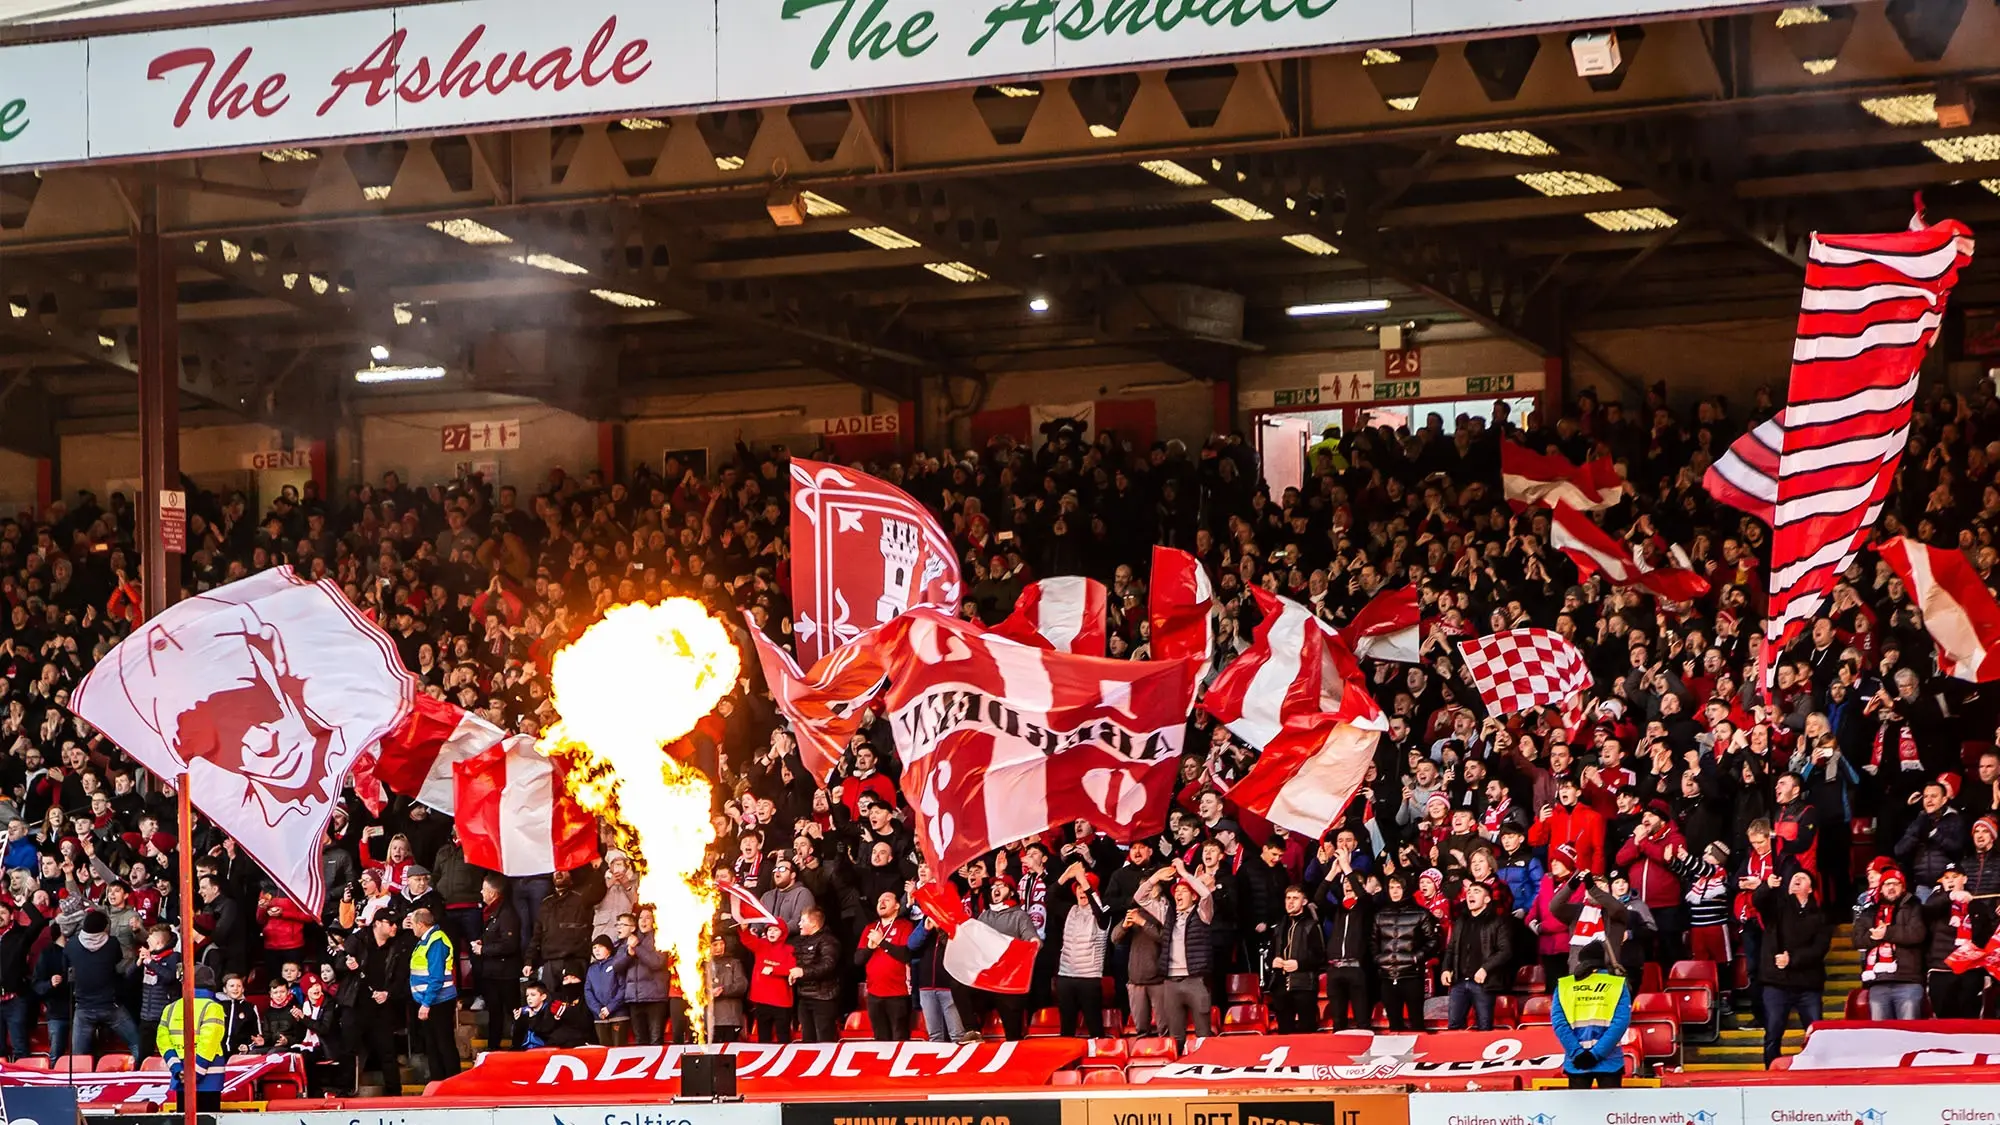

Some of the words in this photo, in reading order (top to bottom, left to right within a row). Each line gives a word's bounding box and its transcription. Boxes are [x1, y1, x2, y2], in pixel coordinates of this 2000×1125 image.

[781, 0, 938, 70] The
[968, 0, 1338, 57] Asva
[147, 46, 290, 128] The
[316, 14, 652, 117] Ashvale
[824, 415, 897, 434] LADIES
[443, 428, 467, 449] 27
[1572, 984, 1593, 992] SGL
[1448, 1115, 1498, 1125] Children
[1500, 1115, 1525, 1125] with
[1606, 1112, 1656, 1124] Children
[1659, 1112, 1684, 1124] with
[1771, 1109, 1823, 1122] Children
[1826, 1109, 1853, 1121] with
[1941, 1108, 1995, 1121] Children
